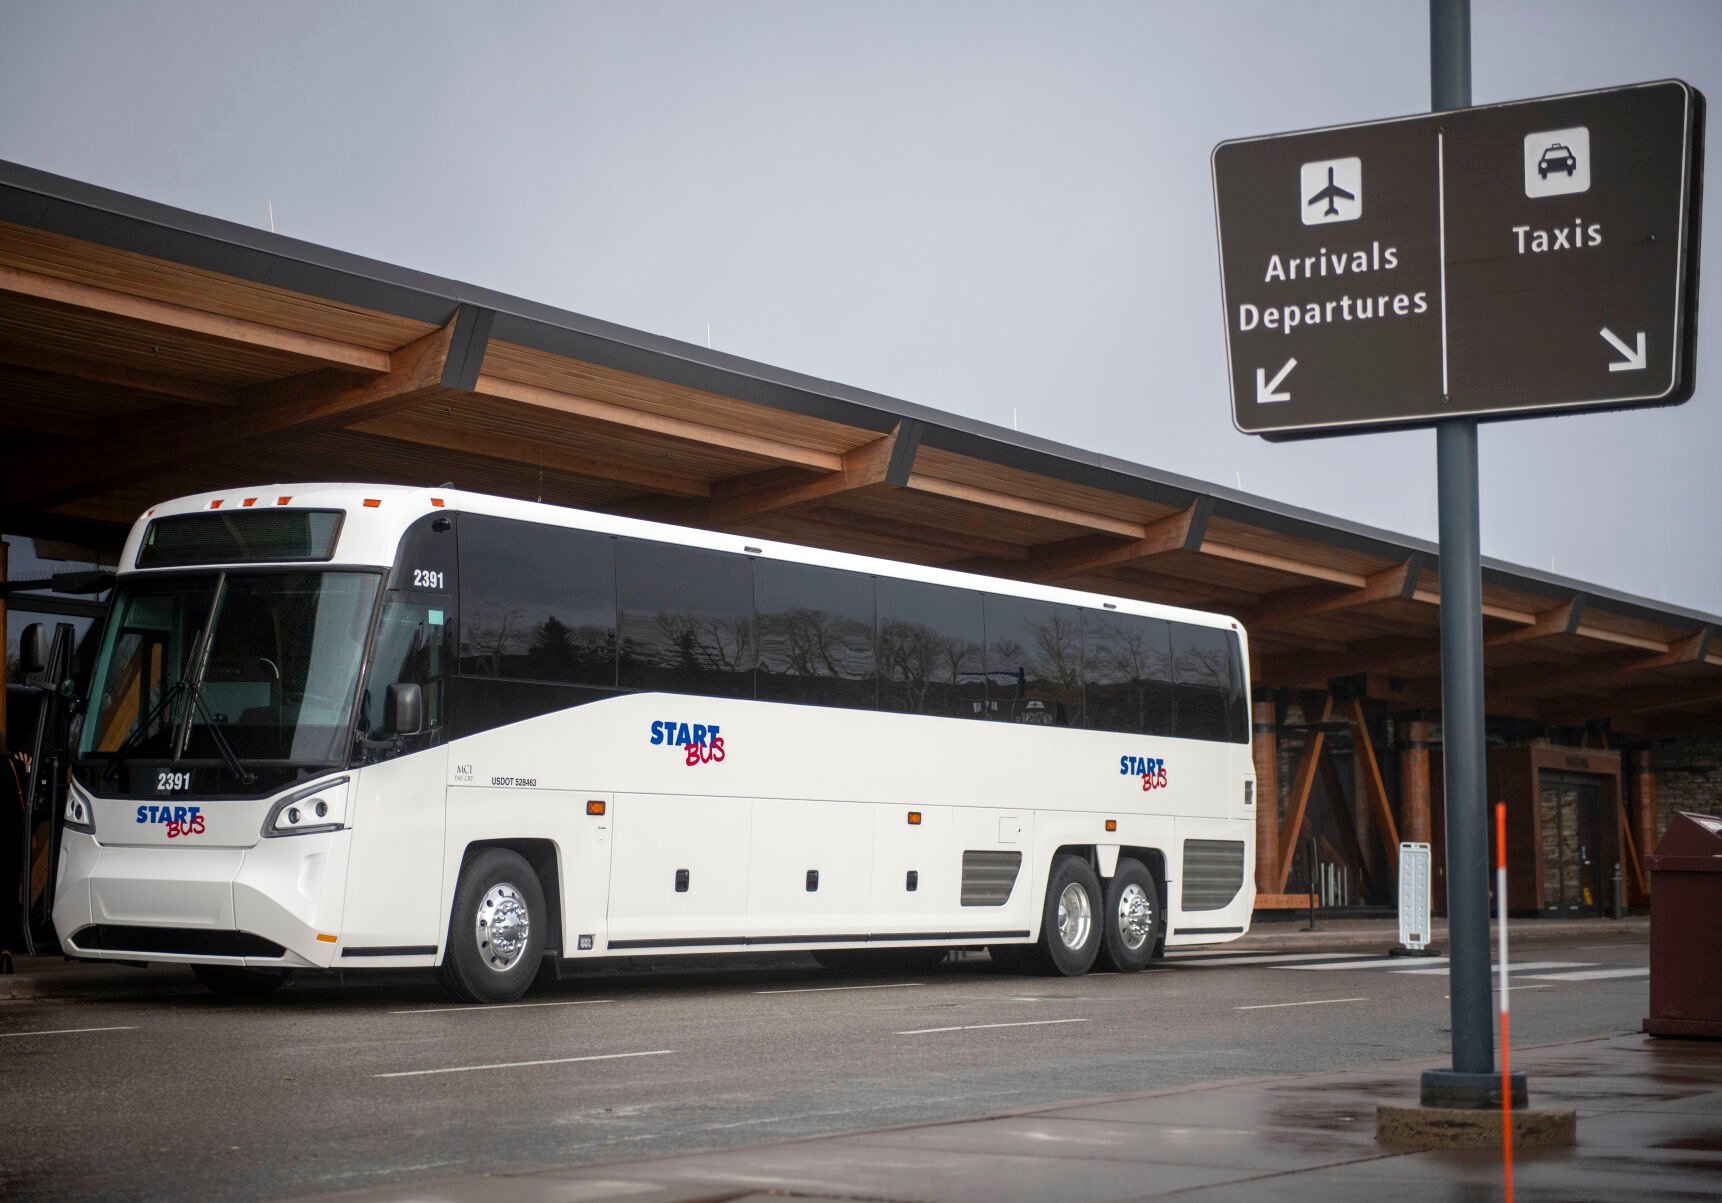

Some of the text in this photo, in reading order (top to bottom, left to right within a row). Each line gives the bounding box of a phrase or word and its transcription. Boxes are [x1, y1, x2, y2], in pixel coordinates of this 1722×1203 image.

[1513, 218, 1603, 254] Taxis
[1265, 241, 1399, 282] Arrivals
[1239, 291, 1428, 334] Departures
[414, 569, 443, 588] 2391
[650, 720, 720, 747] START
[684, 737, 725, 766] BUS
[457, 764, 473, 774] MCI
[1120, 755, 1164, 775] START
[157, 772, 190, 790] 2391
[491, 776, 537, 787] USDOT 528463
[1142, 768, 1168, 791] BUS
[136, 805, 200, 824] START
[166, 815, 206, 838] BUS
